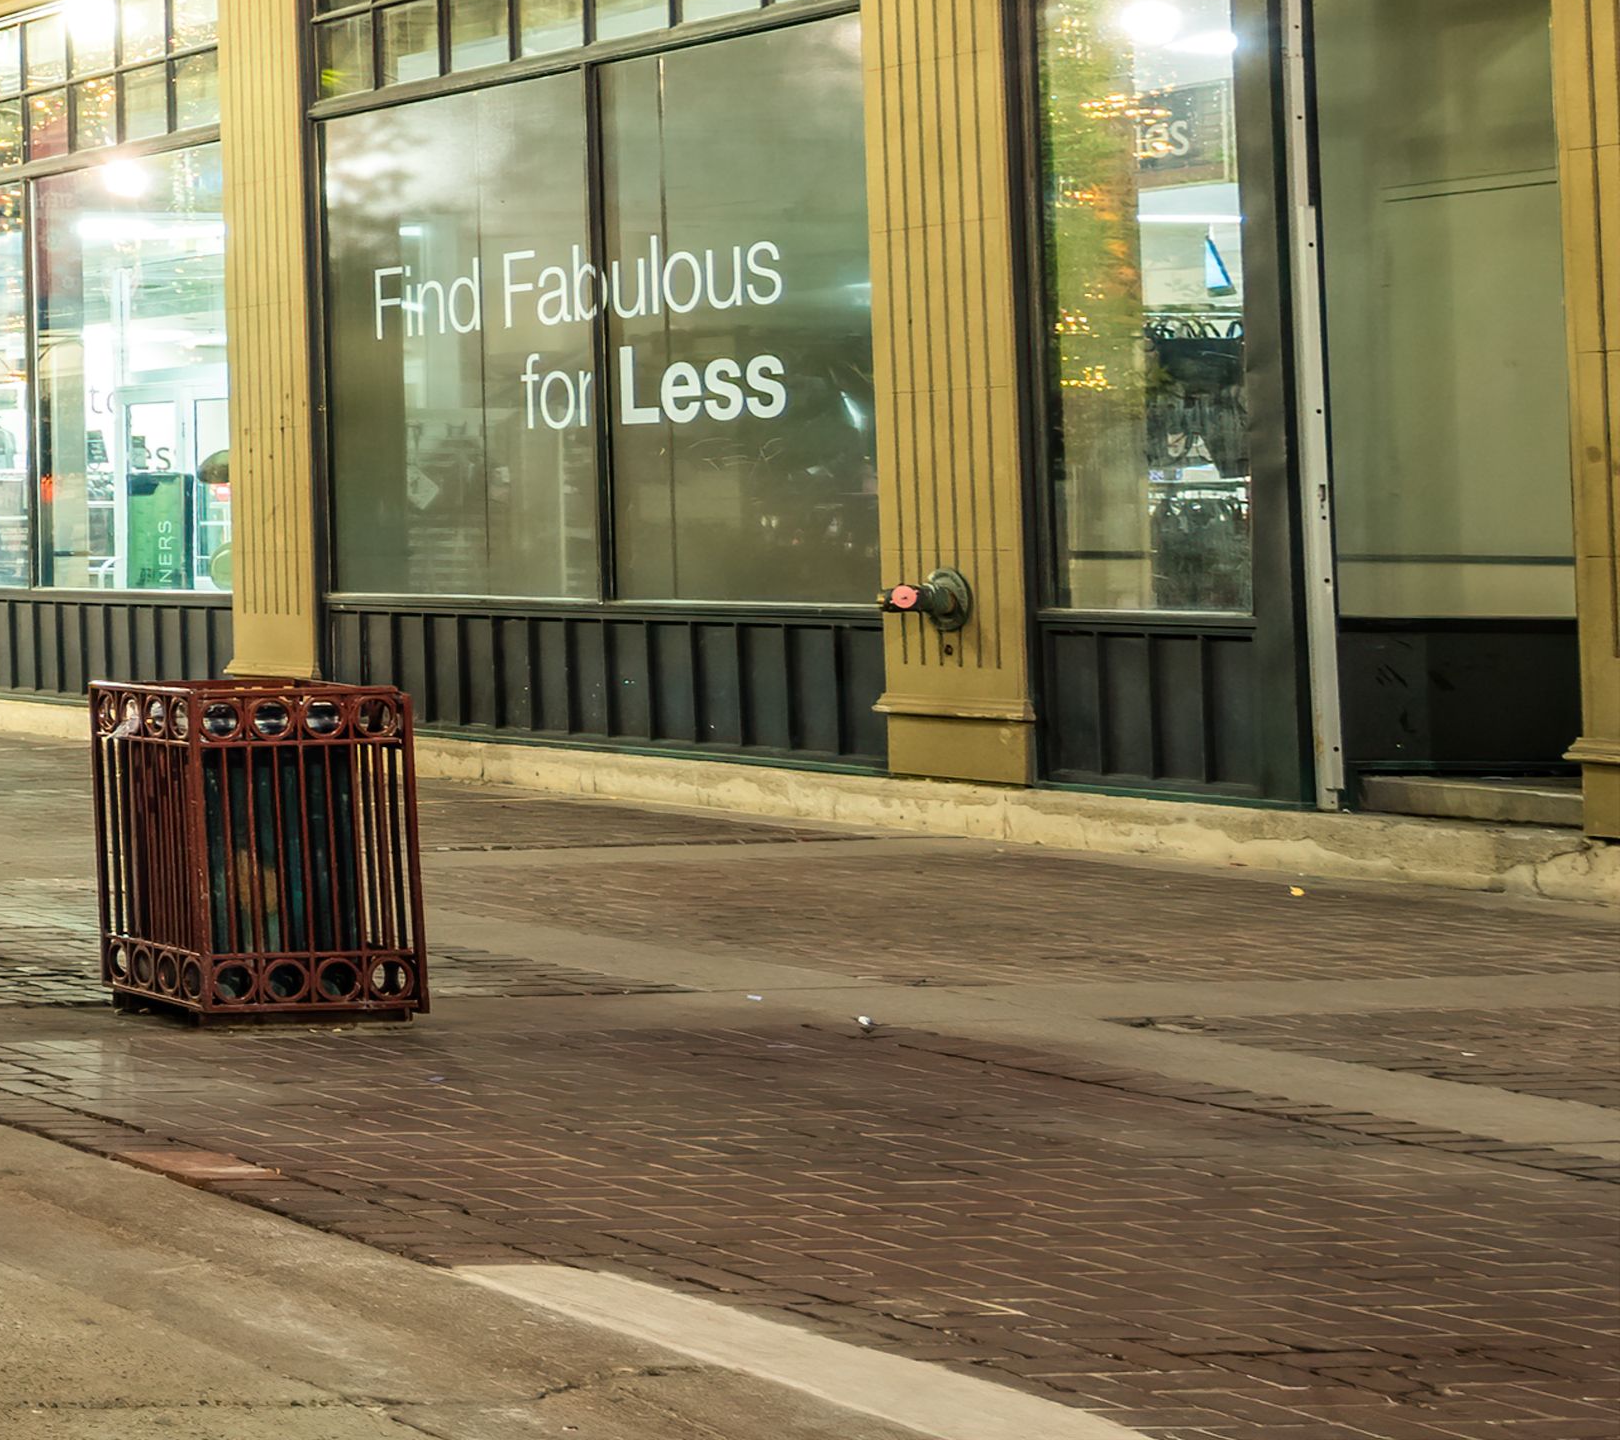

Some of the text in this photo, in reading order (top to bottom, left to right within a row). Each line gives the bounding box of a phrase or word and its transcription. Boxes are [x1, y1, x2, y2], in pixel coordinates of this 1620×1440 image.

[374, 234, 783, 340] Find Fabulous
[520, 345, 787, 430] for Less
[158, 519, 173, 588] NERS
